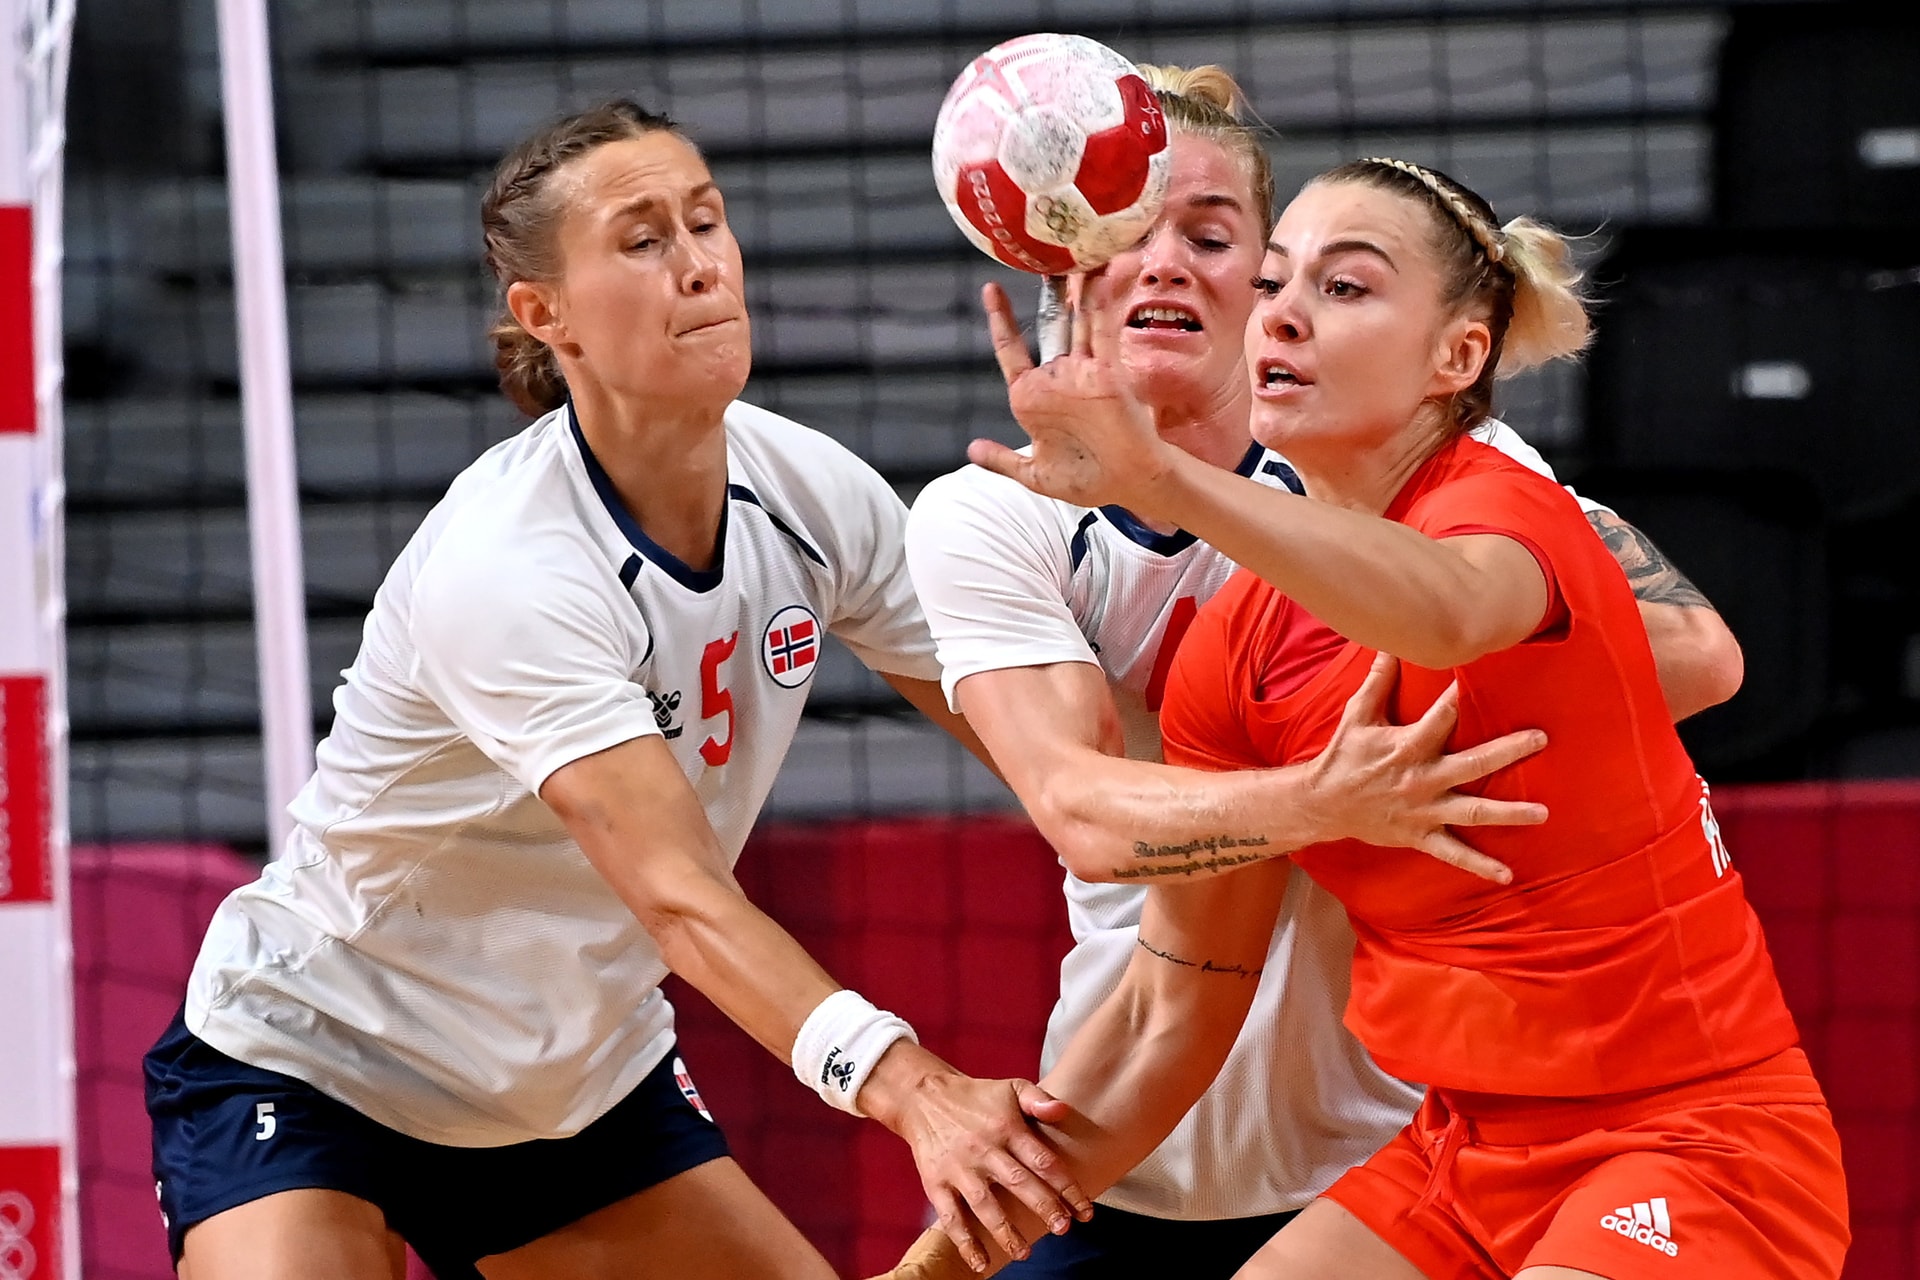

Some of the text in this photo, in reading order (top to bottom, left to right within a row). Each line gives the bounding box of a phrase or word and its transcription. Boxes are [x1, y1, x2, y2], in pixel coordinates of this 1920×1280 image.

[967, 168, 1004, 228] 2020
[699, 630, 739, 767] 5
[1203, 836, 1218, 855] of
[1219, 834, 1237, 849] the
[821, 1046, 843, 1086] hummel
[255, 1102, 277, 1141] 5
[1600, 1214, 1679, 1257] adidas
